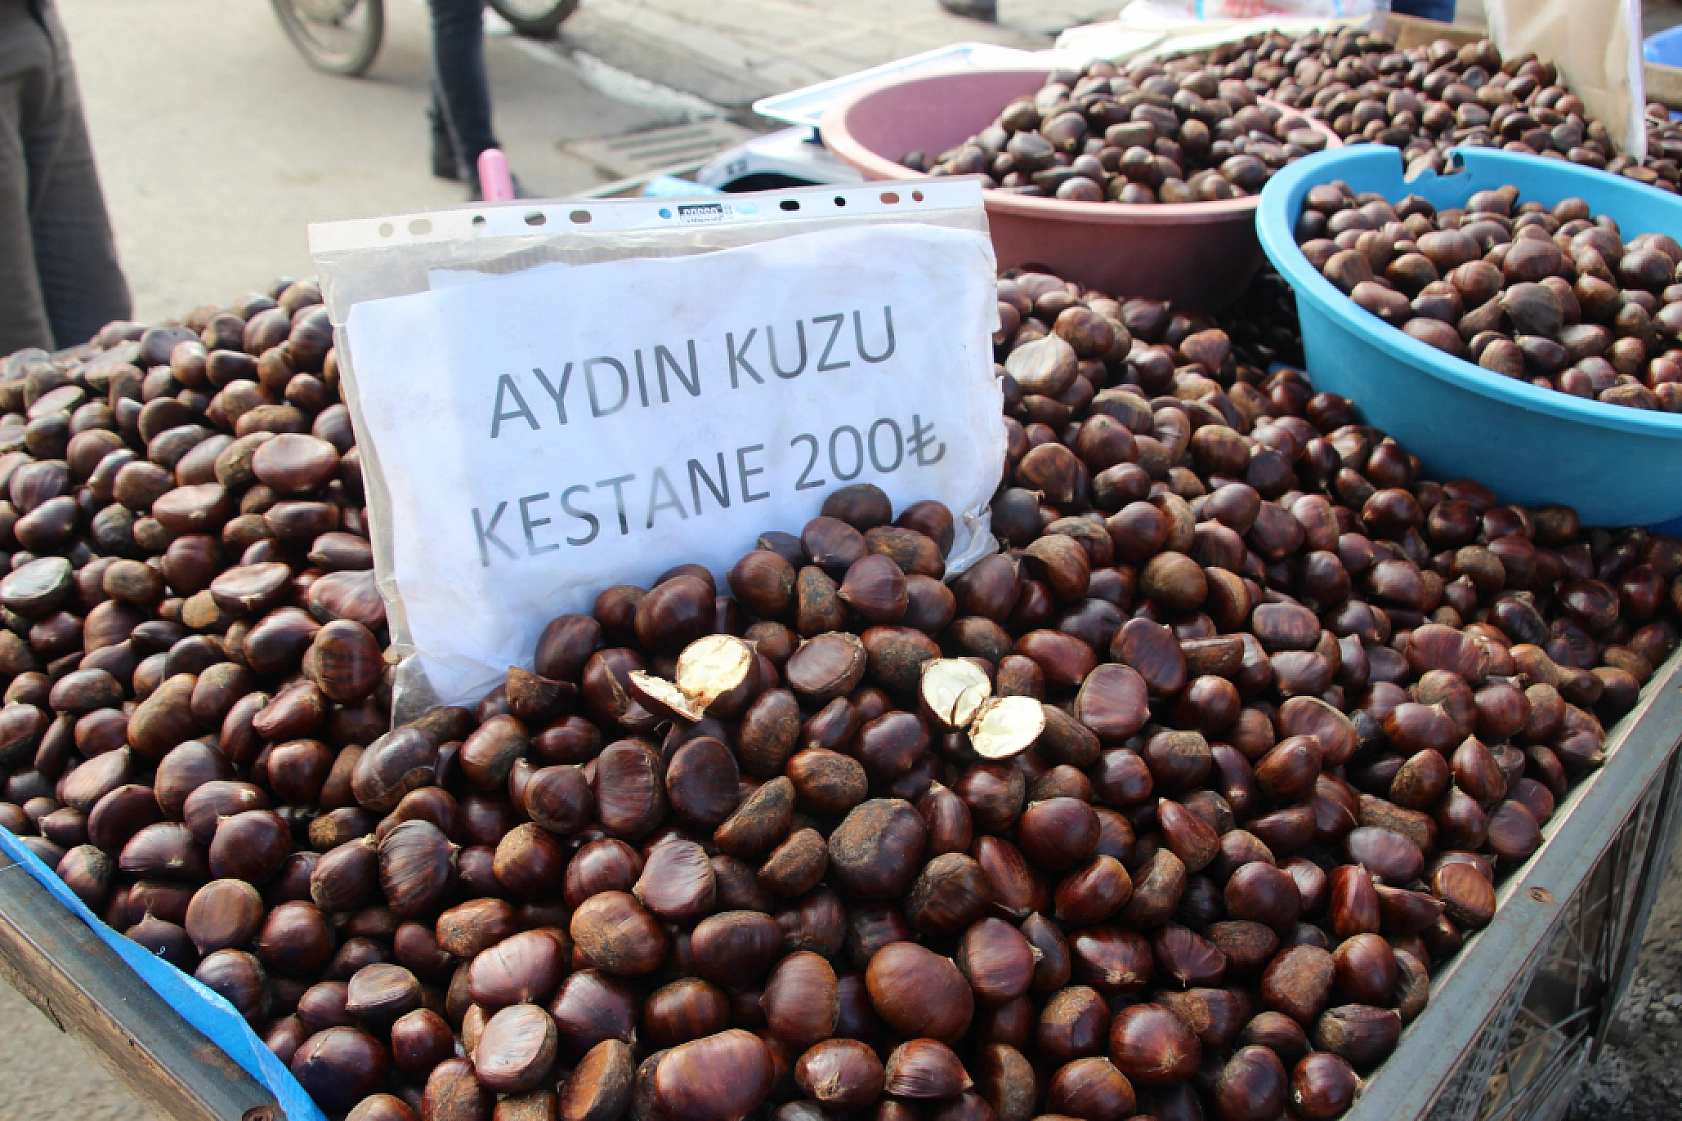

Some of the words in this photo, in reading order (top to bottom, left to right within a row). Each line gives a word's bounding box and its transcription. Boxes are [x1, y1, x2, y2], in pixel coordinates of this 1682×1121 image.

[490, 339, 701, 439] AYDIN
[725, 306, 897, 390] KUZU
[471, 444, 771, 568] KESTANE
